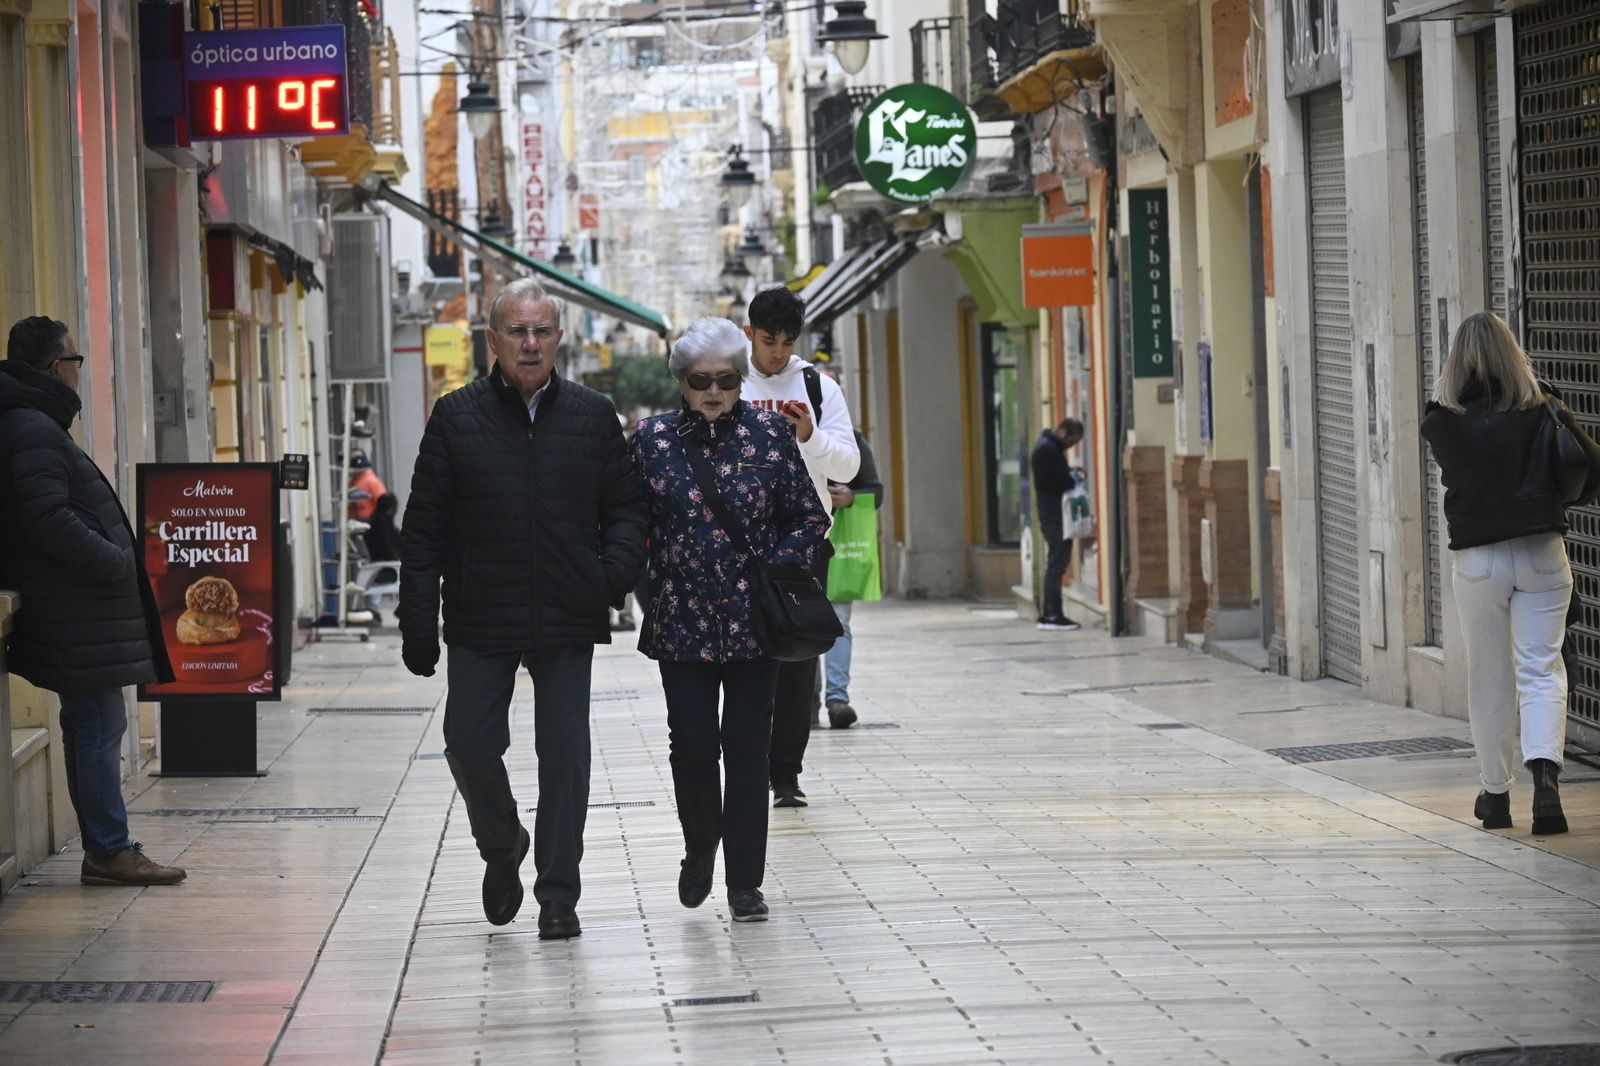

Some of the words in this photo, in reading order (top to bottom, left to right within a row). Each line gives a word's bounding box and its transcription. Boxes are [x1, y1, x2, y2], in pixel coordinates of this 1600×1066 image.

[191, 43, 258, 68] óptica
[263, 41, 338, 62] urbano
[213, 84, 257, 132] 11
[1029, 267, 1087, 278] bankinter
[1145, 201, 1163, 364] Herbolario
[183, 479, 234, 498] Malvón
[171, 507, 194, 518] SOLO
[195, 507, 207, 517] EN
[208, 507, 246, 517] NAVIDAD
[159, 520, 258, 541] Carrillera
[168, 542, 250, 568] Especial
[181, 661, 207, 670] EDICIÓN
[207, 661, 238, 670] LIMITADA
